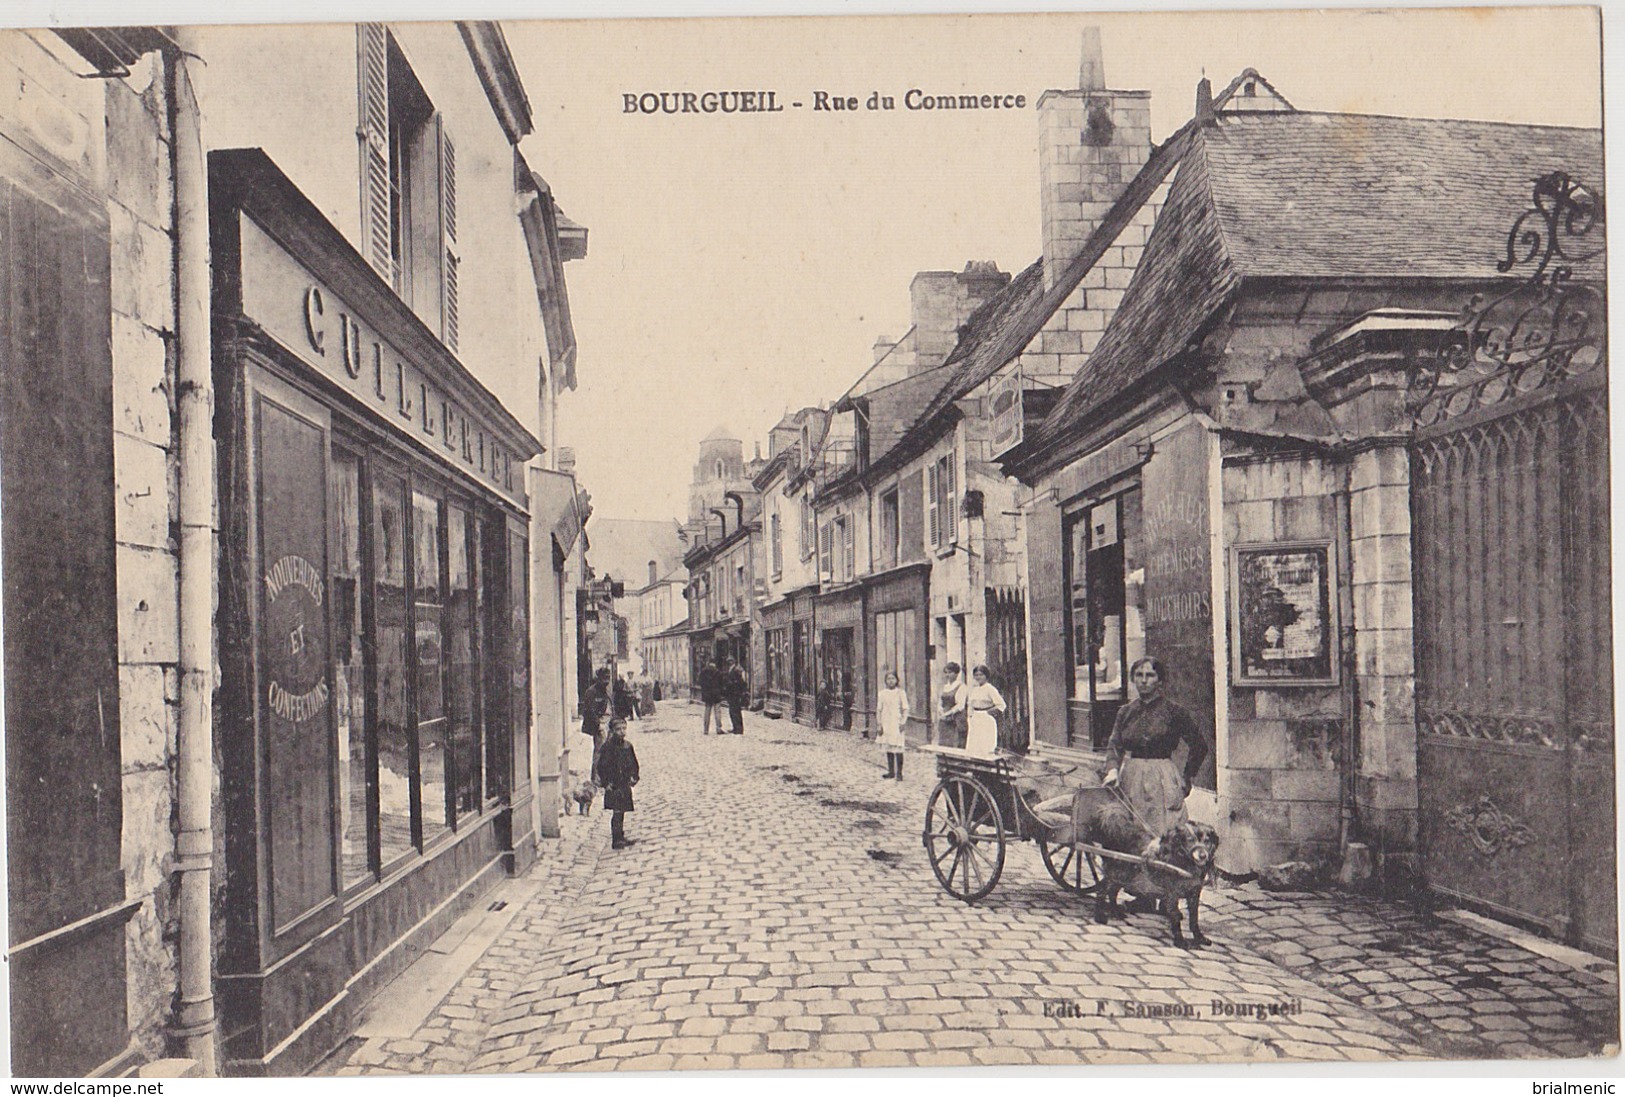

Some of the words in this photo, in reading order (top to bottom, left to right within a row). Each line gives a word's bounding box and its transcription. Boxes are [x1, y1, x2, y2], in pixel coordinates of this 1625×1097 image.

[1150, 545, 1205, 577] CHEMISES
[290, 624, 305, 655] ET
[268, 676, 329, 723] CONFECTIONS
